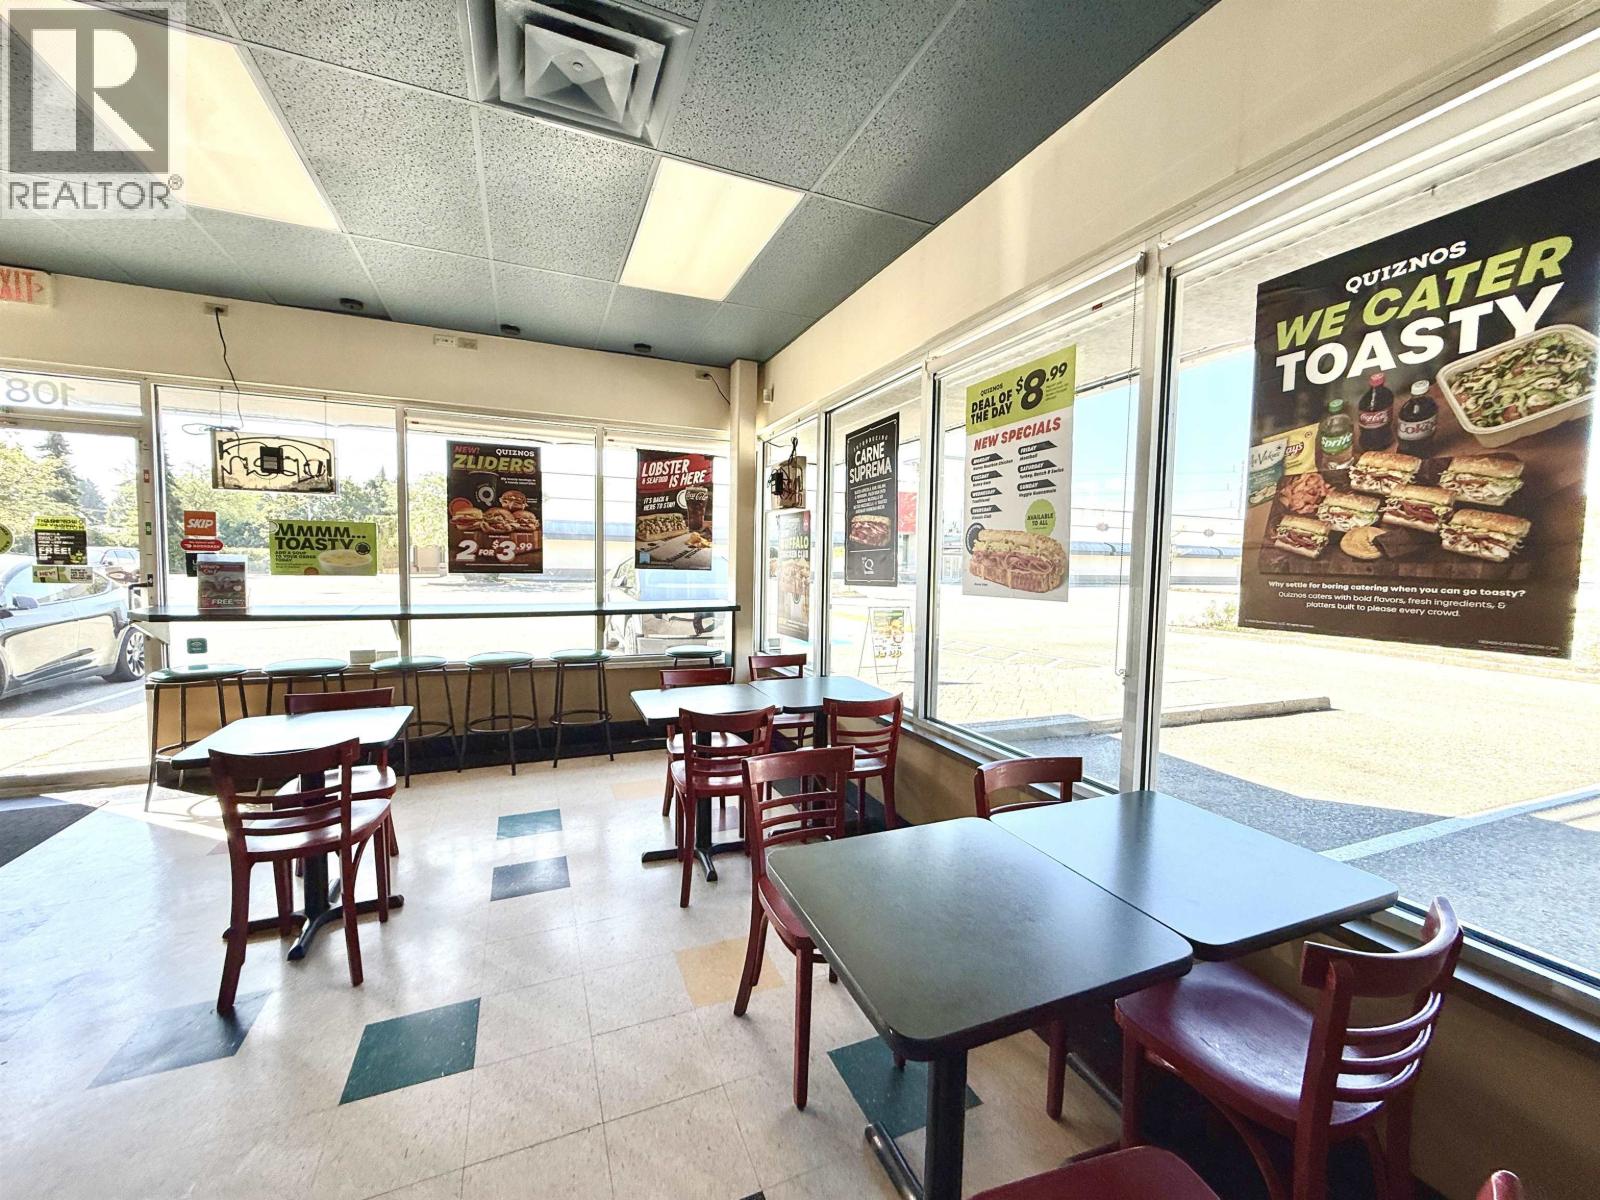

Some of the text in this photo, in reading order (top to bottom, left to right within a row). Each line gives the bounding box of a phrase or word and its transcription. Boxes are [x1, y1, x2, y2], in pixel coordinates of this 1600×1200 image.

[1345, 241, 1467, 294] QUIZNOS
[1276, 236, 1573, 351] WE CATER
[1276, 282, 1565, 392] TOASTY
[980, 383, 1003, 396] QUIZNOS
[972, 389, 1012, 413] DEAL OF
[971, 401, 1012, 424] THE DAY
[974, 416, 1061, 451] NEW SPECIALS
[454, 446, 534, 456] NEW! QUIZNOS
[854, 435, 888, 452] INTRODUCING
[1020, 446, 1037, 454] FRIDAY
[453, 454, 536, 472] ZLIDERS
[855, 442, 885, 466] CARNE
[642, 459, 690, 477] LOBSTER
[850, 456, 892, 484] SUPREMA
[1020, 463, 1044, 472] SATURDAY
[646, 476, 668, 484] SEAFOOD
[669, 475, 679, 488] IS
[680, 470, 707, 486] HERE
[187, 518, 214, 528] SKIP
[275, 524, 366, 538] MMMM...
[275, 537, 354, 550] TOASTY
[456, 540, 478, 561] 2
[1278, 591, 1306, 599] Quiznos
[1374, 595, 1405, 604] flavors,
[1434, 599, 1495, 609] ingredients,
[1351, 584, 1388, 592] catering
[1480, 589, 1526, 598] toasty?
